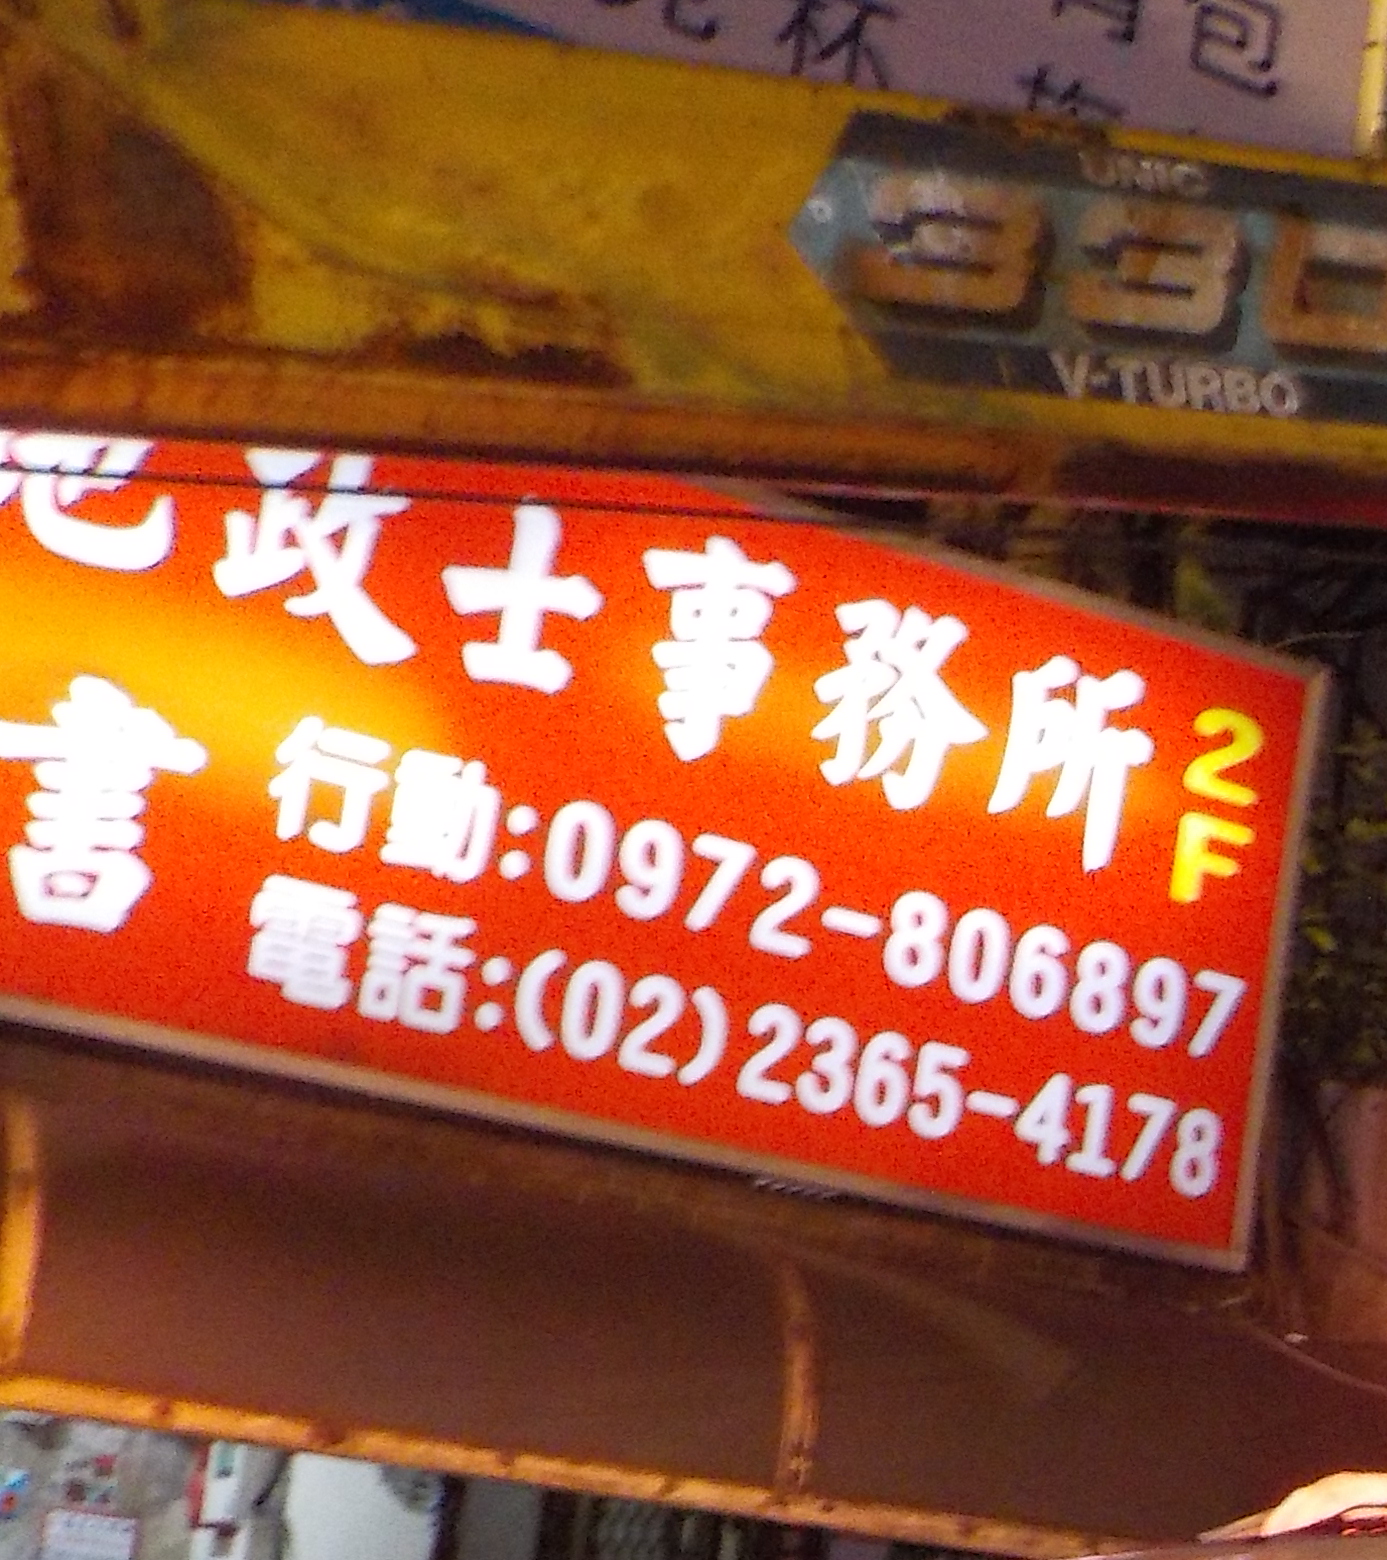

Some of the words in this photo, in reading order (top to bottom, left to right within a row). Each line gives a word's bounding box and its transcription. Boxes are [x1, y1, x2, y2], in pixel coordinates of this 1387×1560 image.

[1050, 350, 1302, 419] V-TURBO
[0, 672, 208, 934] 書
[1169, 706, 1265, 904] 2F
